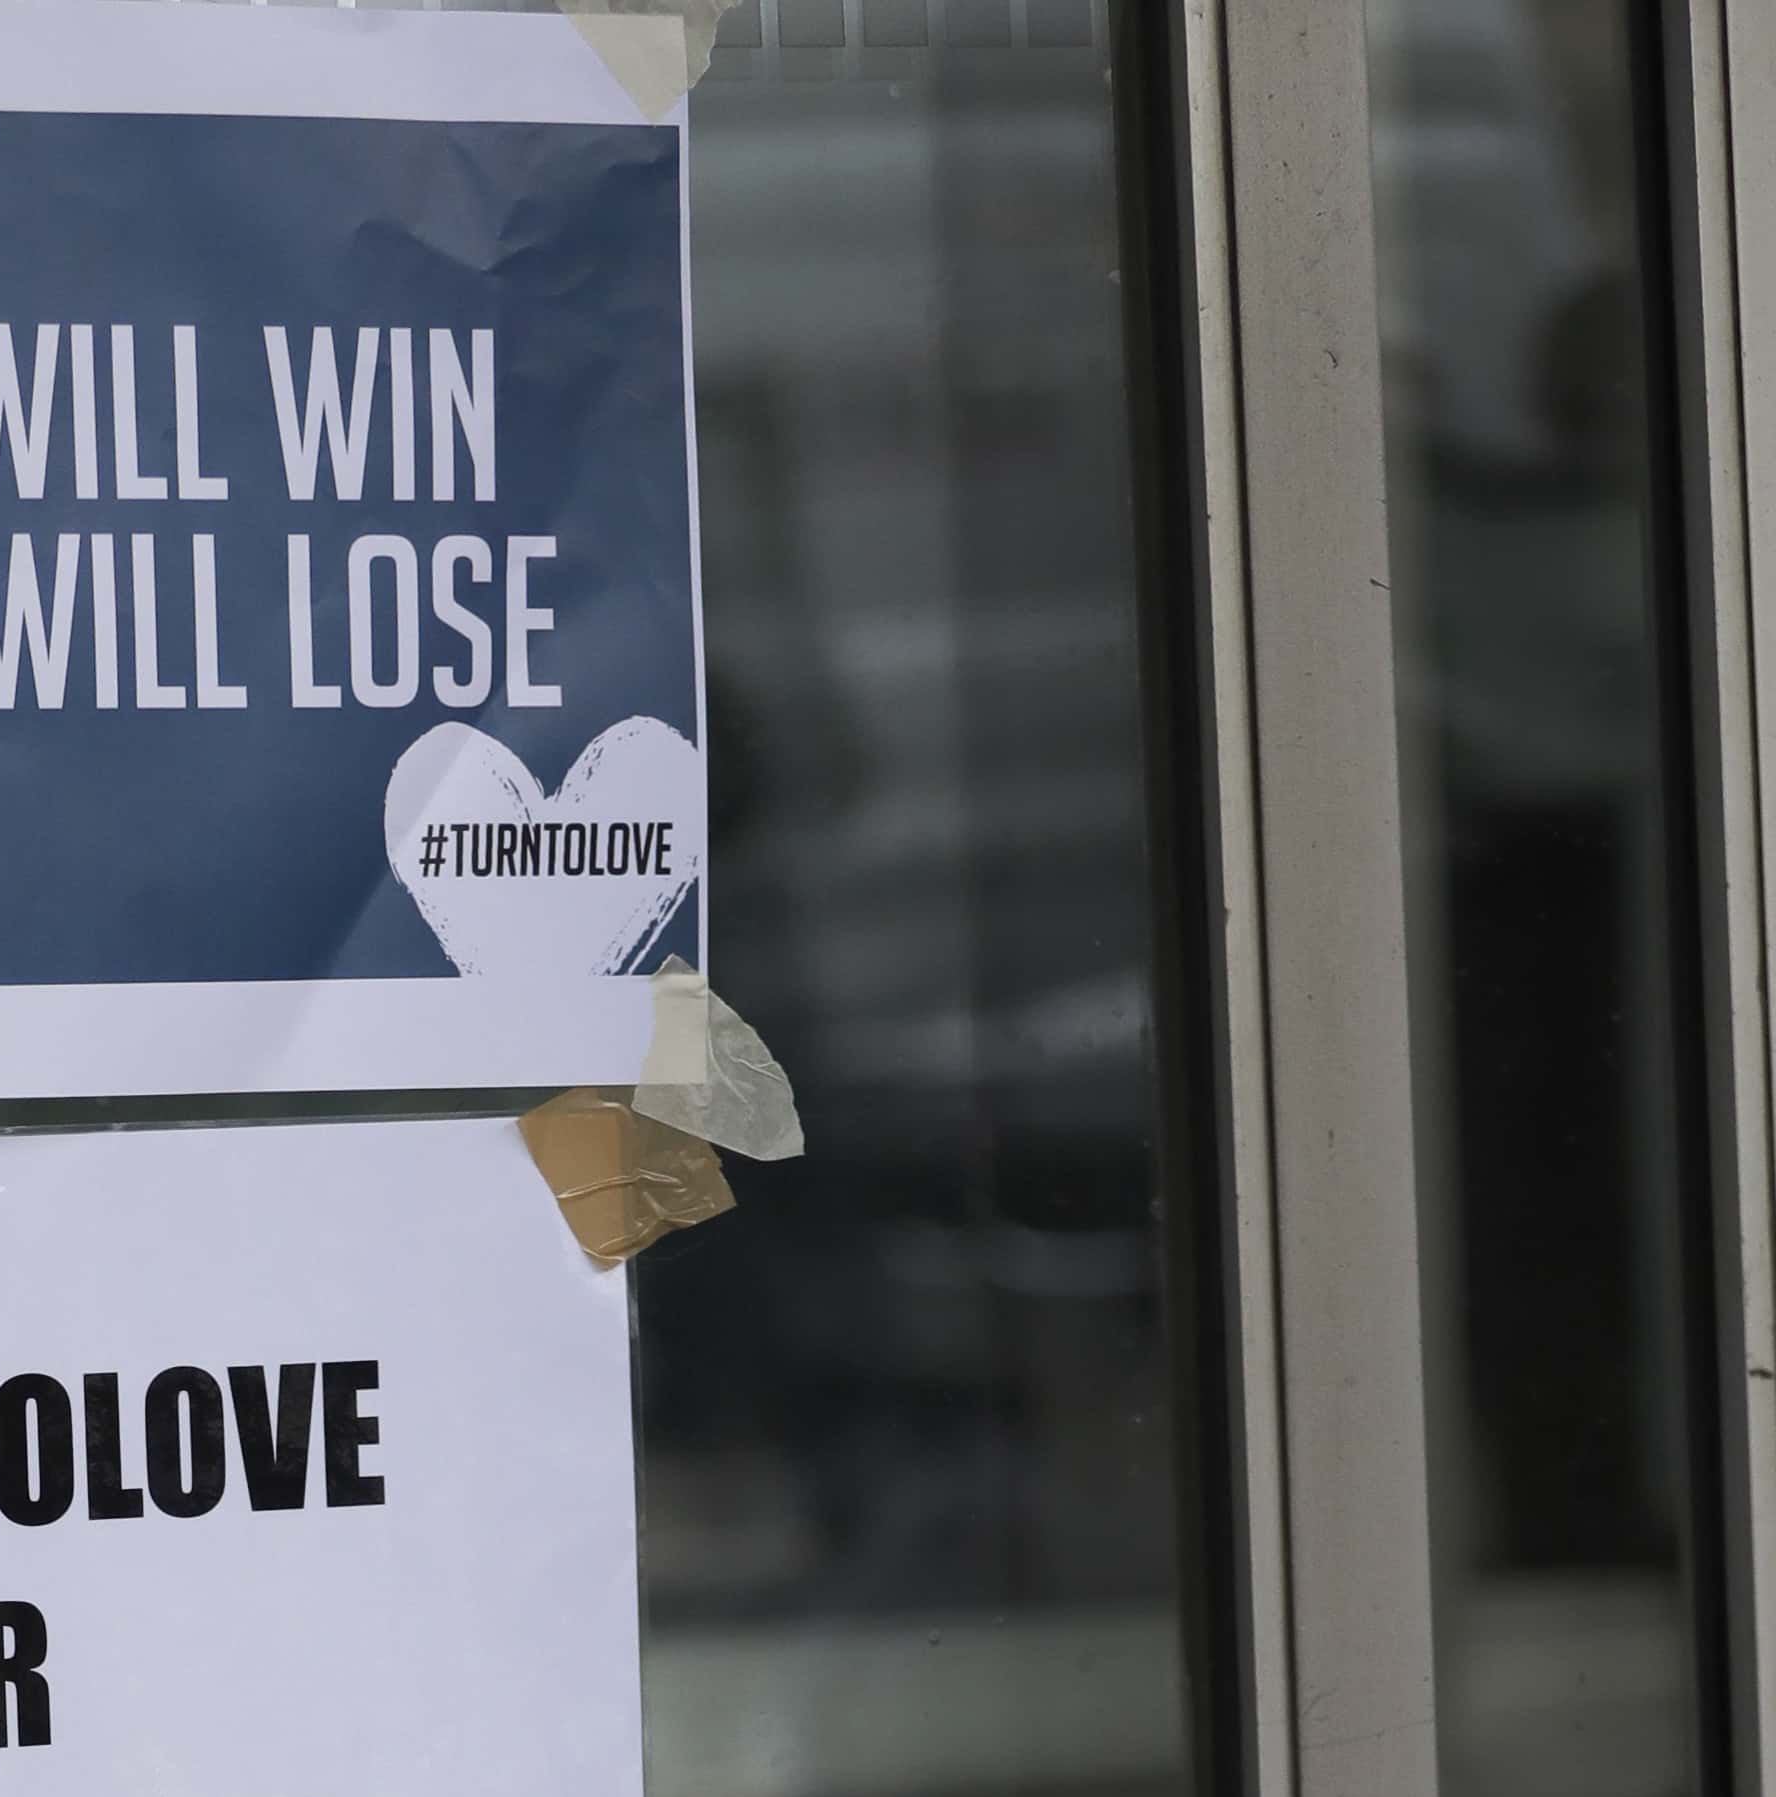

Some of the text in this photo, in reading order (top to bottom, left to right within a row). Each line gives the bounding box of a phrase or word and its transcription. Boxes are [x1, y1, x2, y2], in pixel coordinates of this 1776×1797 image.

[264, 326, 495, 501] WIN
[288, 535, 562, 707] LOSE
[420, 823, 672, 879] #TURNTOLOVE
